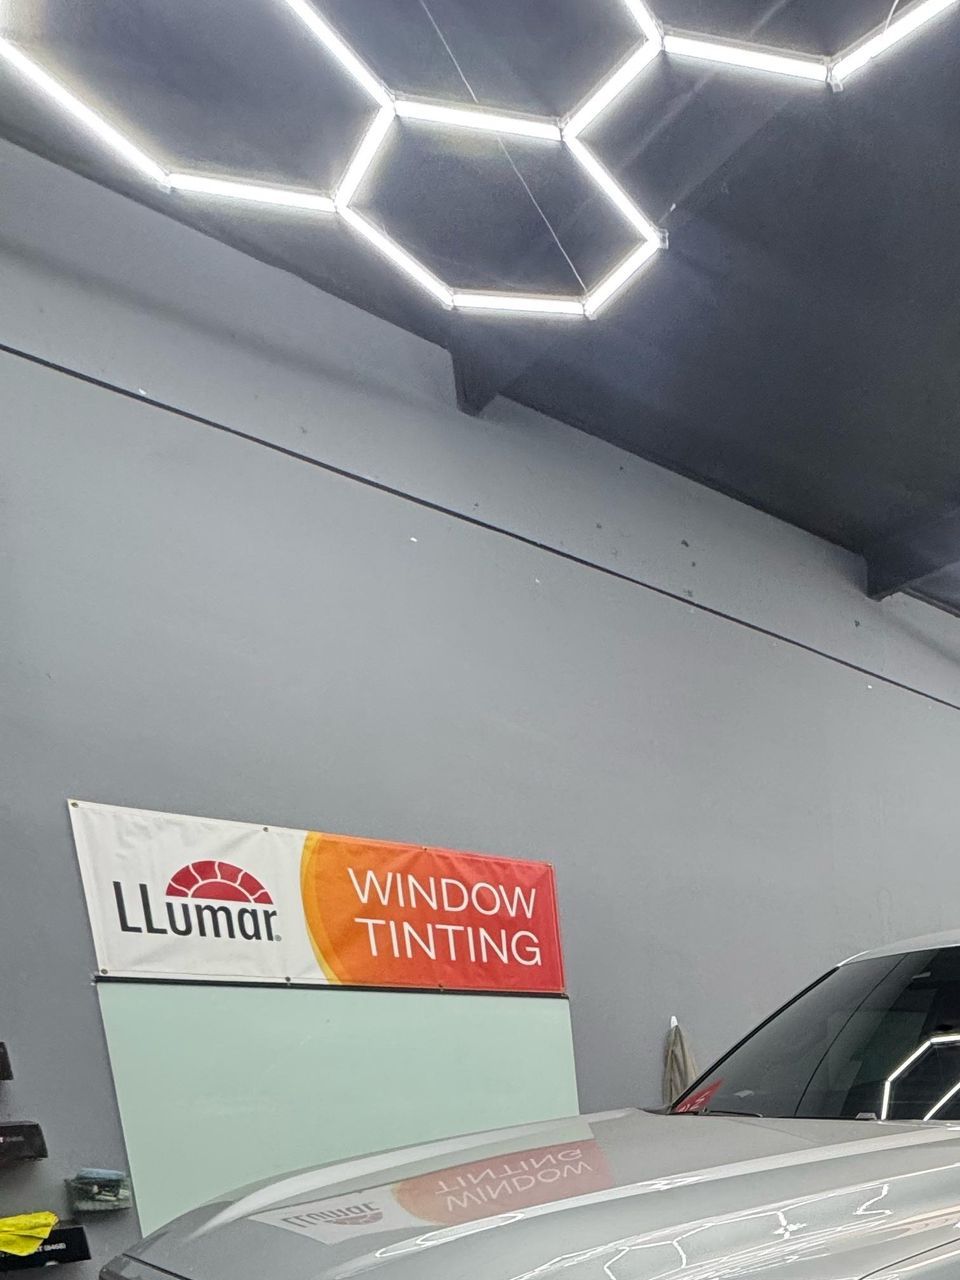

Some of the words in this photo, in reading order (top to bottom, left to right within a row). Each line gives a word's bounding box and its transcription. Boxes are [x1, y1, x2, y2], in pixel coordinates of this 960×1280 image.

[112, 880, 278, 942] LLumar
[348, 867, 536, 919] WINDOW
[354, 917, 542, 967] TINTING
